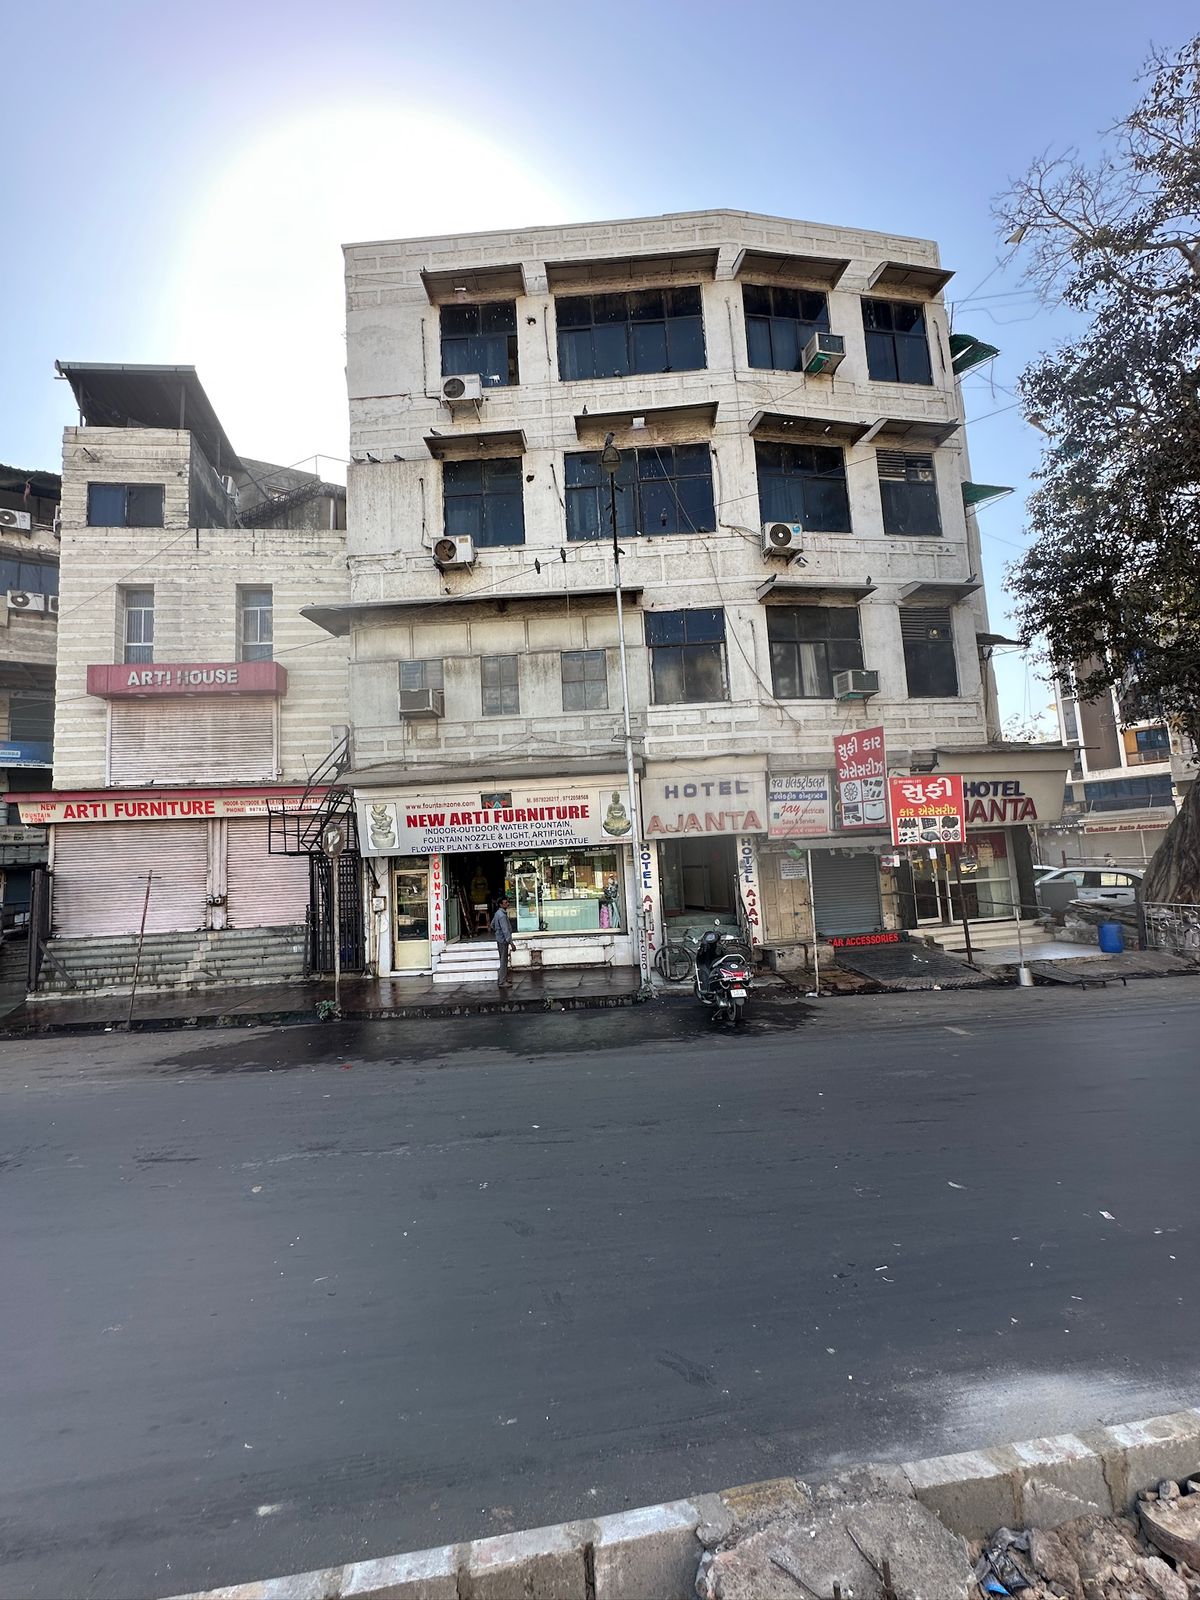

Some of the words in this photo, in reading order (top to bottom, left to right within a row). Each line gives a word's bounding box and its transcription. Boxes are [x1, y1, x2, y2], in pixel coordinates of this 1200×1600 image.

[127, 671, 171, 686] ARTI
[177, 669, 238, 685] HOUSE
[838, 736, 858, 761] સુફી
[862, 736, 881, 751] કાર
[664, 780, 749, 799] HOTEL
[901, 777, 953, 804] સુફી
[963, 781, 1026, 798] HOTEL
[63, 803, 107, 818] ARTI
[114, 800, 216, 818] FURNITURE
[405, 801, 476, 809] www.fountainzone.com
[899, 808, 915, 816] કાર
[406, 813, 446, 828] NEW
[449, 810, 490, 826] ARTI
[493, 805, 590, 824] FURNITURE
[646, 810, 762, 835] AJANTA
[423, 835, 463, 844] FOUNTAIN
[465, 833, 496, 843] NOZZLE
[532, 829, 575, 838] ARTIFICIAL
[425, 824, 499, 835] INDOOR-OUTDOOR
[500, 822, 528, 831] WATER
[411, 844, 445, 853] FLOWER
[447, 843, 473, 851] PLANT
[482, 841, 516, 849] FLOWER
[640, 843, 653, 889] HOTEL
[740, 837, 754, 883] HOTEL
[431, 933, 446, 941] ZONE
[845, 932, 899, 946] ACCESSORIES
